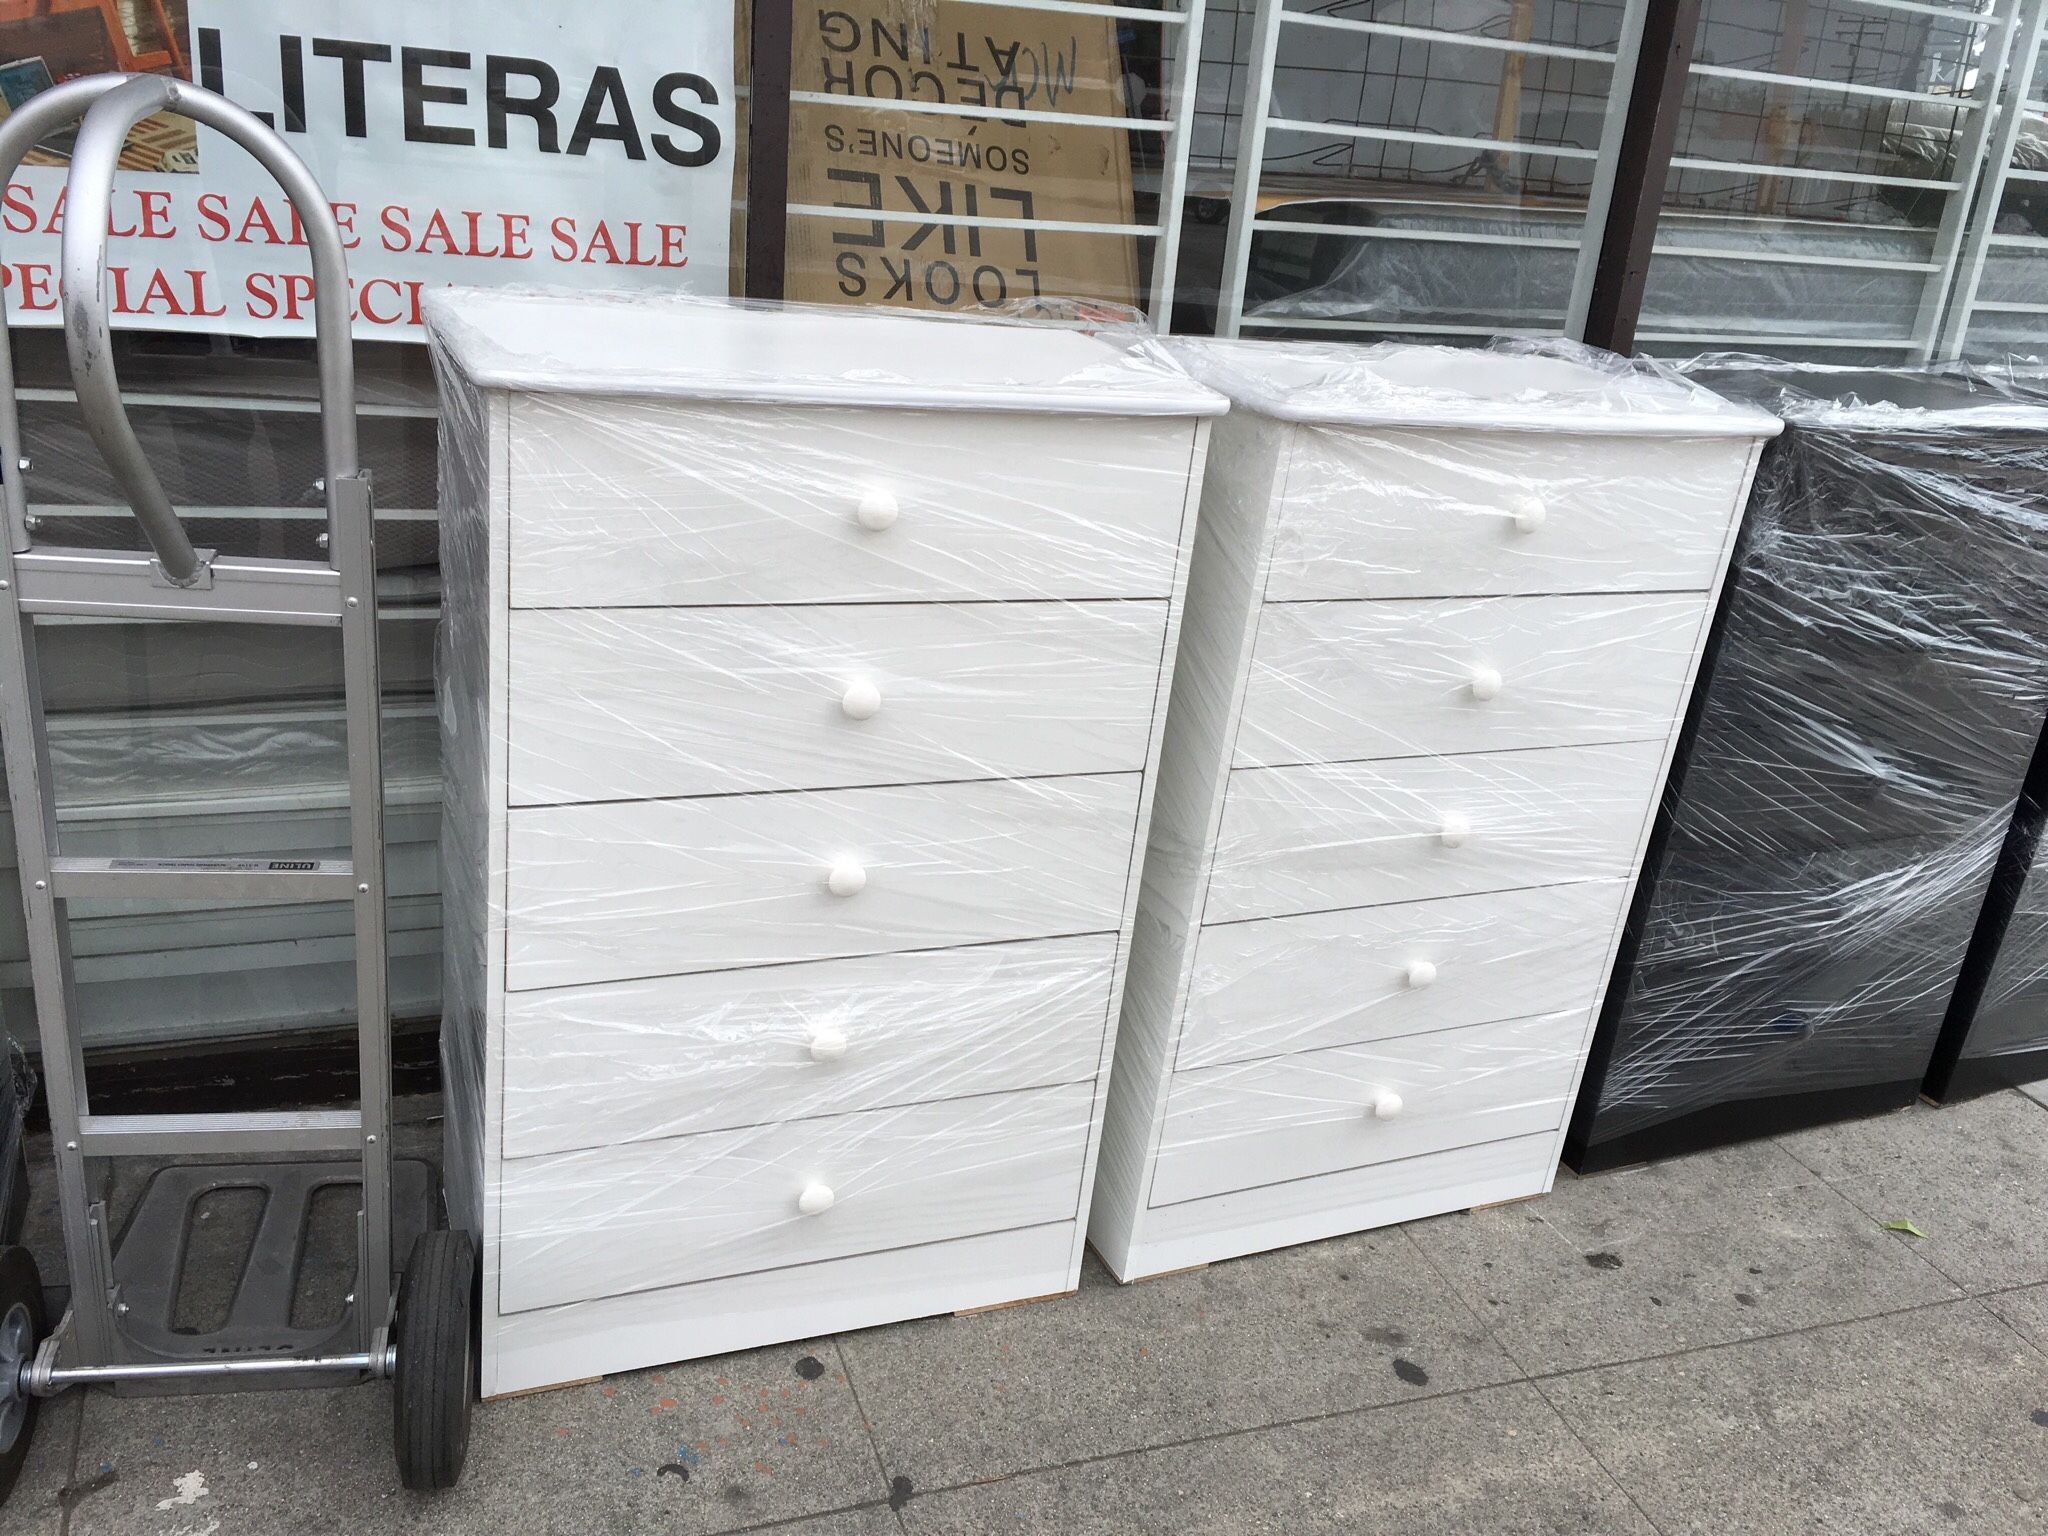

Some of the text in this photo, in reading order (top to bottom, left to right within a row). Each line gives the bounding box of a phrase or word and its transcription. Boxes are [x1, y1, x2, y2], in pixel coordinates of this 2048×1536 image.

[818, 9, 1020, 76] ATING
[198, 27, 721, 167] LITERAS
[825, 124, 1029, 175] SOMEONE'S
[380, 205, 534, 259] SALE
[550, 216, 688, 267] SALE
[827, 168, 1037, 262] LIKE
[836, 252, 1041, 311] LOOKS
